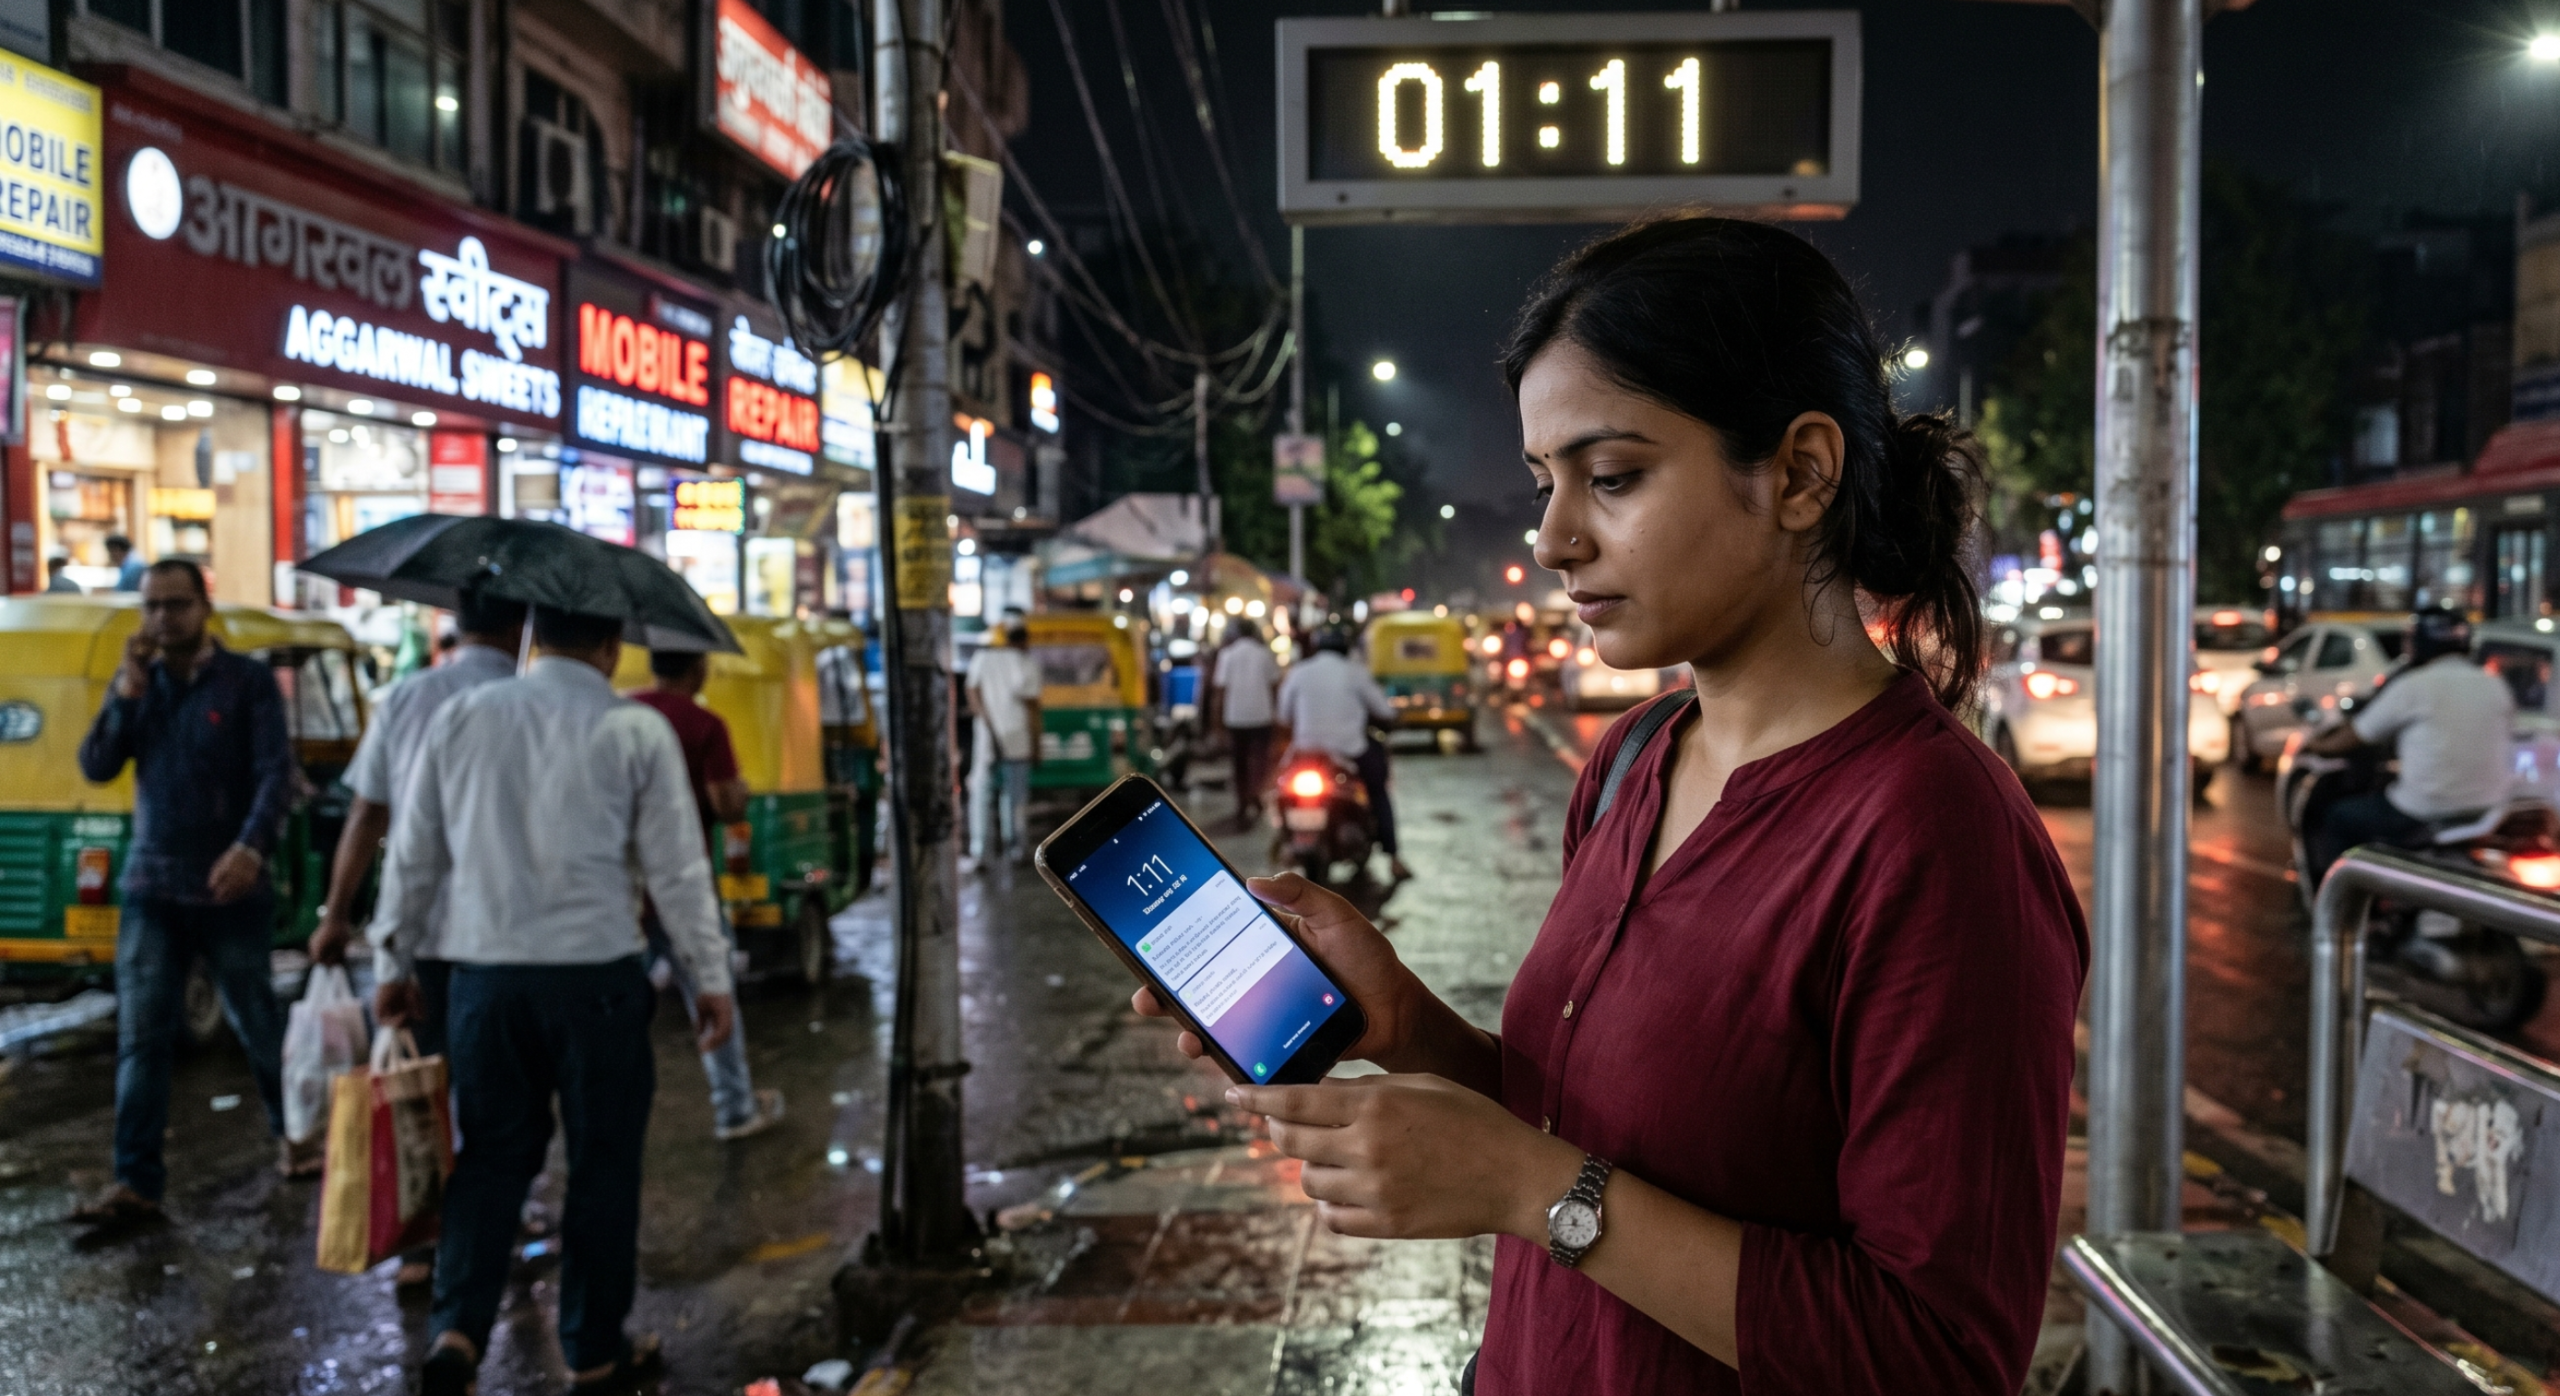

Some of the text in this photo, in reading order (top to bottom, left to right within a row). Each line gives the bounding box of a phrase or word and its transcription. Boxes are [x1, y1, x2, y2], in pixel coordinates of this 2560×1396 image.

[0, 124, 91, 186] OBILE
[1379, 57, 1700, 167] 01:11
[285, 304, 562, 419] AGGARWAL SWEETS
[579, 302, 709, 407] MOBILE
[728, 376, 820, 453] REPAIR
[1126, 853, 1174, 897] 1:11
